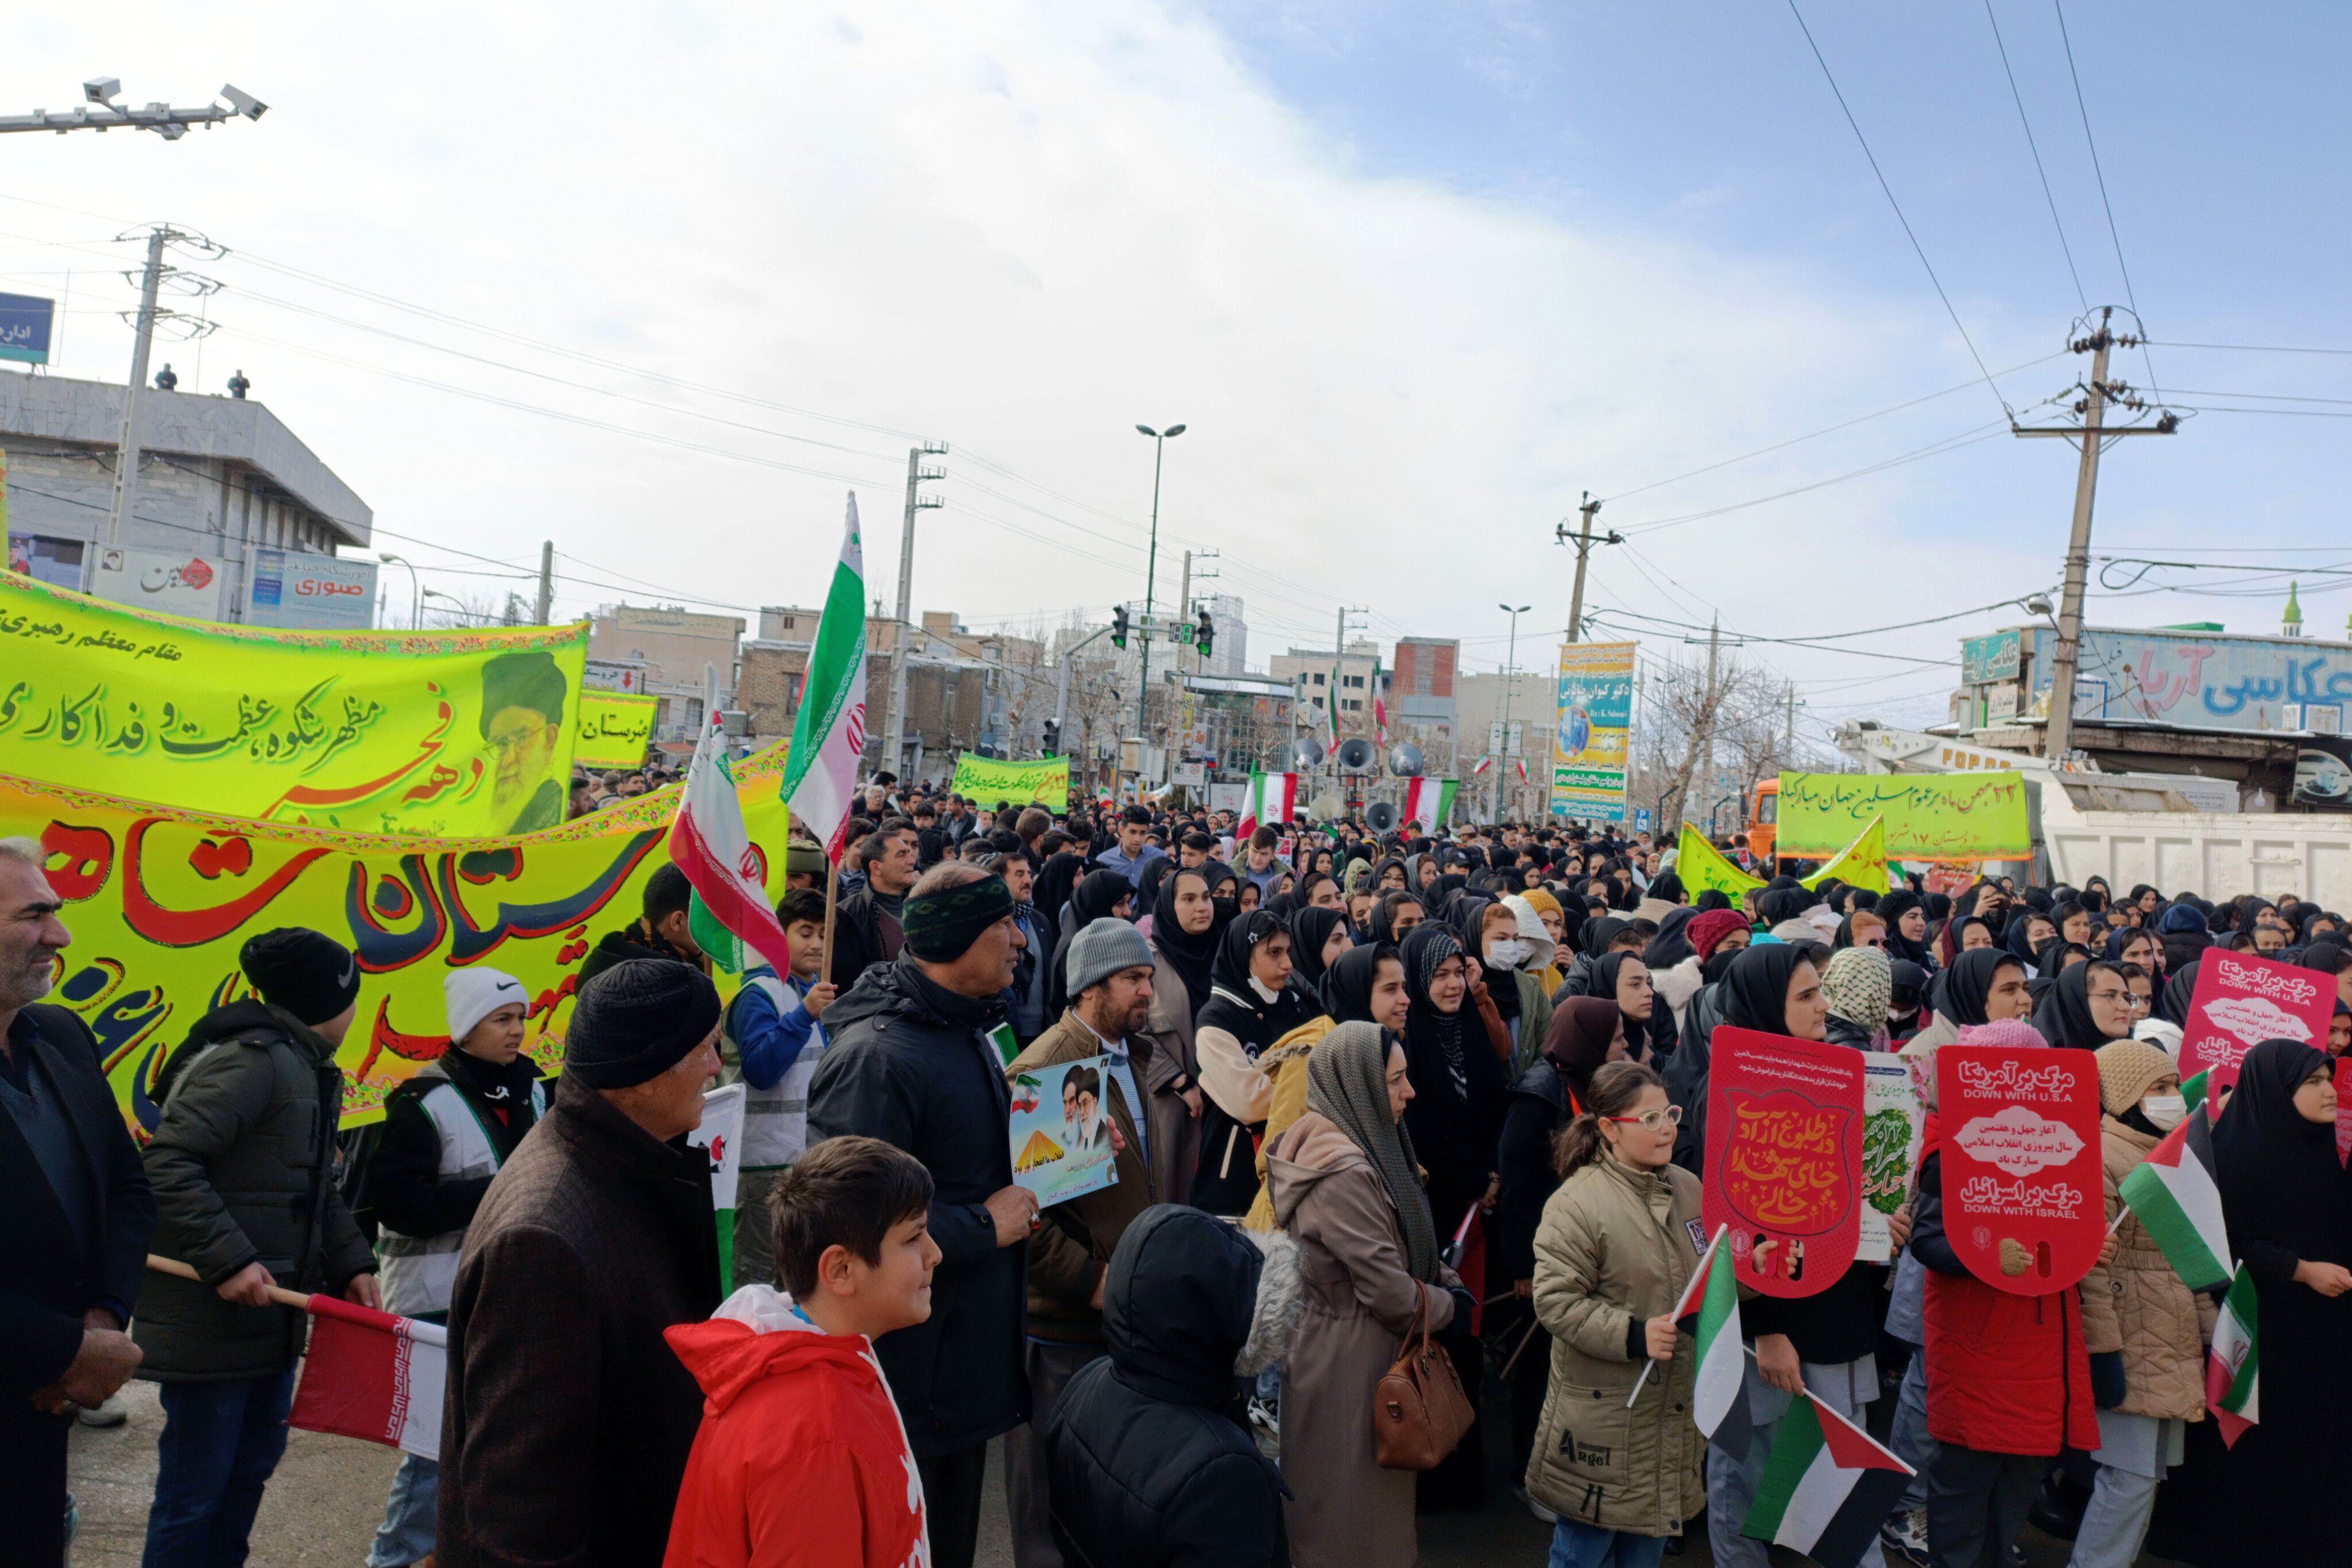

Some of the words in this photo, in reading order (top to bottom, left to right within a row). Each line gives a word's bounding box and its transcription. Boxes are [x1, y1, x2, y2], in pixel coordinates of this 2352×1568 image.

[0, 324, 30, 342] ادار
[295, 579, 363, 598] صبوری
[75, 630, 136, 655] معظم
[134, 642, 182, 661] مقام
[1963, 640, 1987, 680] آریا
[1986, 637, 2018, 677] عکاسی
[2134, 644, 2215, 714] آریا
[2203, 657, 2352, 717] عکاسی
[1611, 683, 1630, 699] دکتر
[159, 693, 276, 754] عظمت
[300, 692, 382, 772] مظهر
[1957, 781, 1993, 813] بهمن
[1993, 783, 2017, 804] ۲۲
[1639, 810, 1646, 819] P
[1913, 833, 1929, 846] ۱۷
[2218, 959, 2272, 983] آمریکا
[2219, 977, 2251, 992] DOWN
[2254, 985, 2281, 999] WITH
[2283, 992, 2311, 1006] U.S.A
[2262, 976, 2284, 992] بر
[2282, 978, 2316, 998] مرگ
[2209, 1011, 2236, 1021] اسلامی
[2237, 1017, 2259, 1027] انقلاب
[2277, 1014, 2292, 1024] آغاز
[2260, 1024, 2287, 1036] پیروزی
[2286, 1028, 2302, 1039] سال
[2197, 1052, 2229, 1067] DOWN
[1958, 1060, 2018, 1090] آمریکا
[2013, 1068, 2038, 1091] بر
[2037, 1065, 2075, 1093] مرگ
[1964, 1089, 2002, 1099] DOWN
[2006, 1090, 2036, 1101] WITH
[2040, 1092, 2072, 1102] U.S.A
[1863, 1116, 1885, 1145] بهم
[1884, 1120, 1904, 1143] ۲۲
[1979, 1124, 2009, 1134] هفتمین
[2010, 1127, 2016, 1135] و
[2017, 1125, 2037, 1136] چهل
[2039, 1124, 2057, 1136] آغاز
[1963, 1138, 1995, 1149] اسلامی
[1995, 1139, 2022, 1149] انقلاب
[2022, 1141, 2055, 1153] پیروزی
[2055, 1141, 2073, 1153] سال
[1862, 1142, 1905, 1176] سراس
[1997, 1154, 2010, 1166] باد
[2011, 1155, 2039, 1166] مبارک
[1960, 1175, 2024, 1205] اسرائیل
[2022, 1184, 2044, 1207] بر
[2042, 1182, 2083, 1209] مرگ
[1964, 1203, 2001, 1214] DOWN
[2003, 1205, 2033, 1217] WITH
[2036, 1207, 2080, 1219] ISRAEL
[1558, 1428, 1611, 1467] Angel
